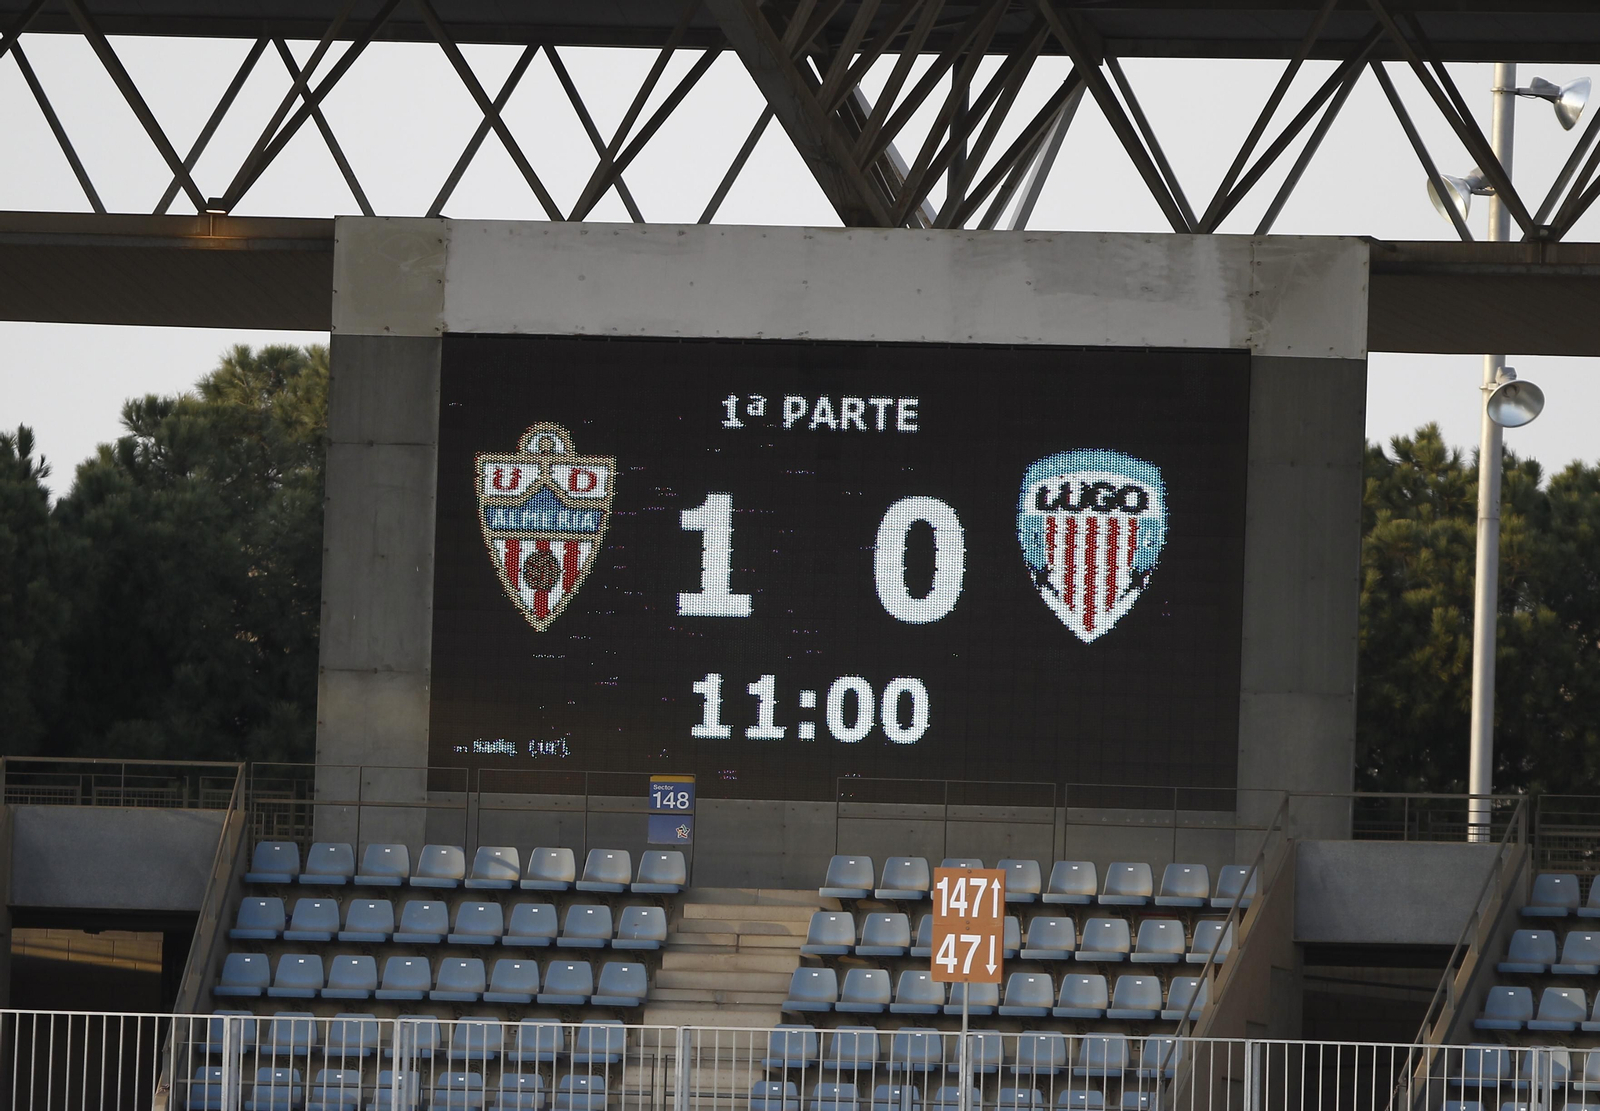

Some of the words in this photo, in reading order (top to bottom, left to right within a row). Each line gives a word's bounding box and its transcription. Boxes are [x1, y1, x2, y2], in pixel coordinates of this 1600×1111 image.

[782, 394, 920, 432] PARTE
[493, 467, 522, 491] U
[568, 468, 598, 492] D
[1036, 482, 1149, 514] LUGO
[677, 491, 753, 618] 1
[873, 495, 967, 625] 0
[691, 672, 930, 745] 11:00
[652, 791, 689, 809] 148
[936, 877, 988, 918] 147
[936, 934, 981, 974] 47
